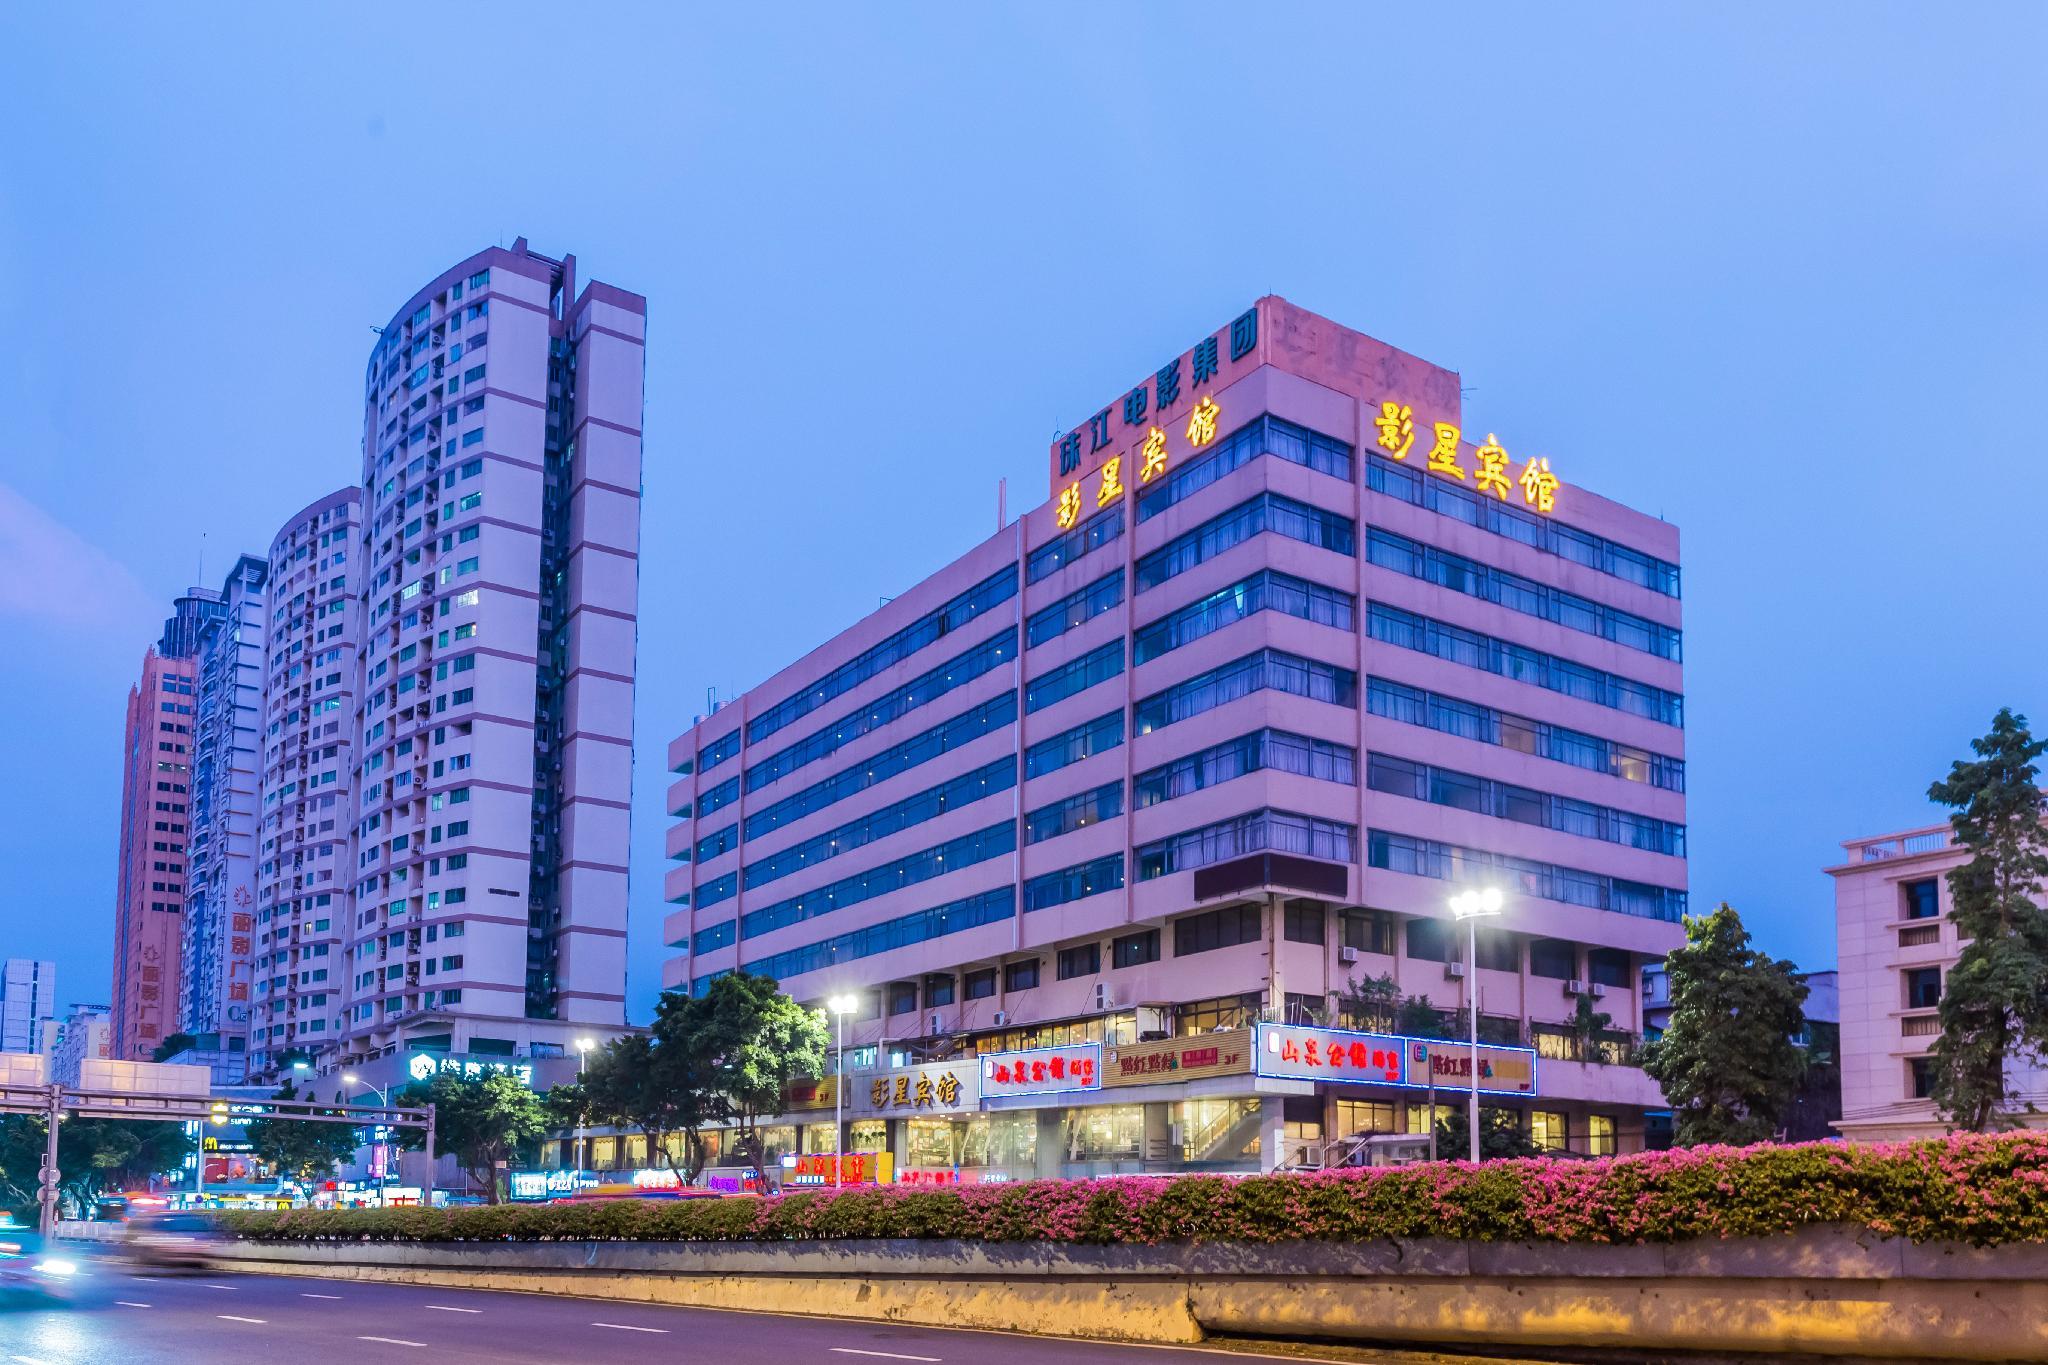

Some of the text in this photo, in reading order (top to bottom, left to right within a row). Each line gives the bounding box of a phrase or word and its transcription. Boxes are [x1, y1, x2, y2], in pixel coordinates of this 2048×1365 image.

[1059, 307, 1258, 477] 珠江电影集团
[1055, 396, 1221, 529] 影星宾馆
[1375, 401, 1561, 513] 影星宾馆
[871, 1072, 960, 1108] 影星宾馆
